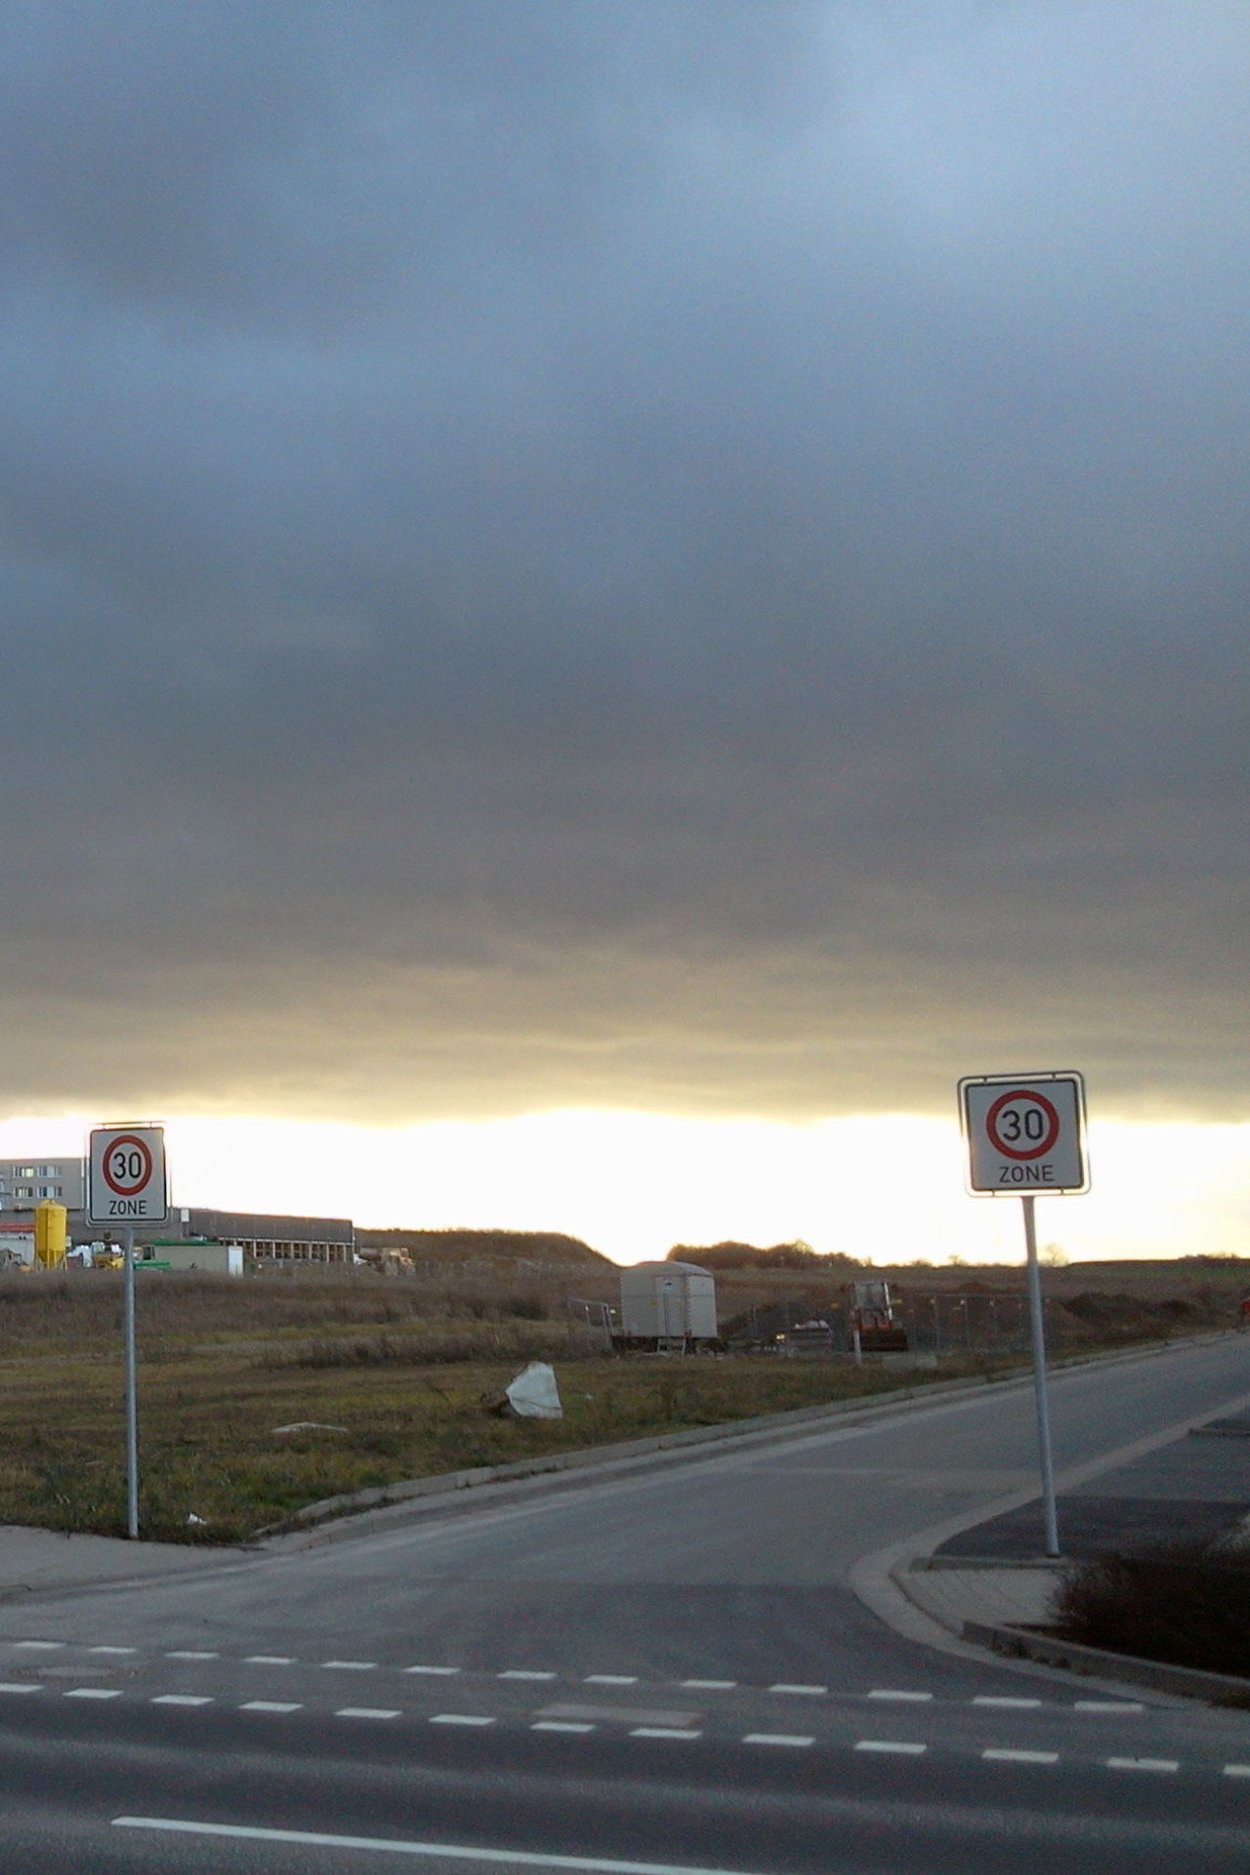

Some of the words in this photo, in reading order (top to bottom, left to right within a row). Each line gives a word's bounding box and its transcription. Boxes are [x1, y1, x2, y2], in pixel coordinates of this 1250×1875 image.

[1002, 1108, 1043, 1141] 30
[113, 1152, 142, 1179] 30
[999, 1165, 1054, 1183] ZONE
[109, 1200, 147, 1215] ZONE
